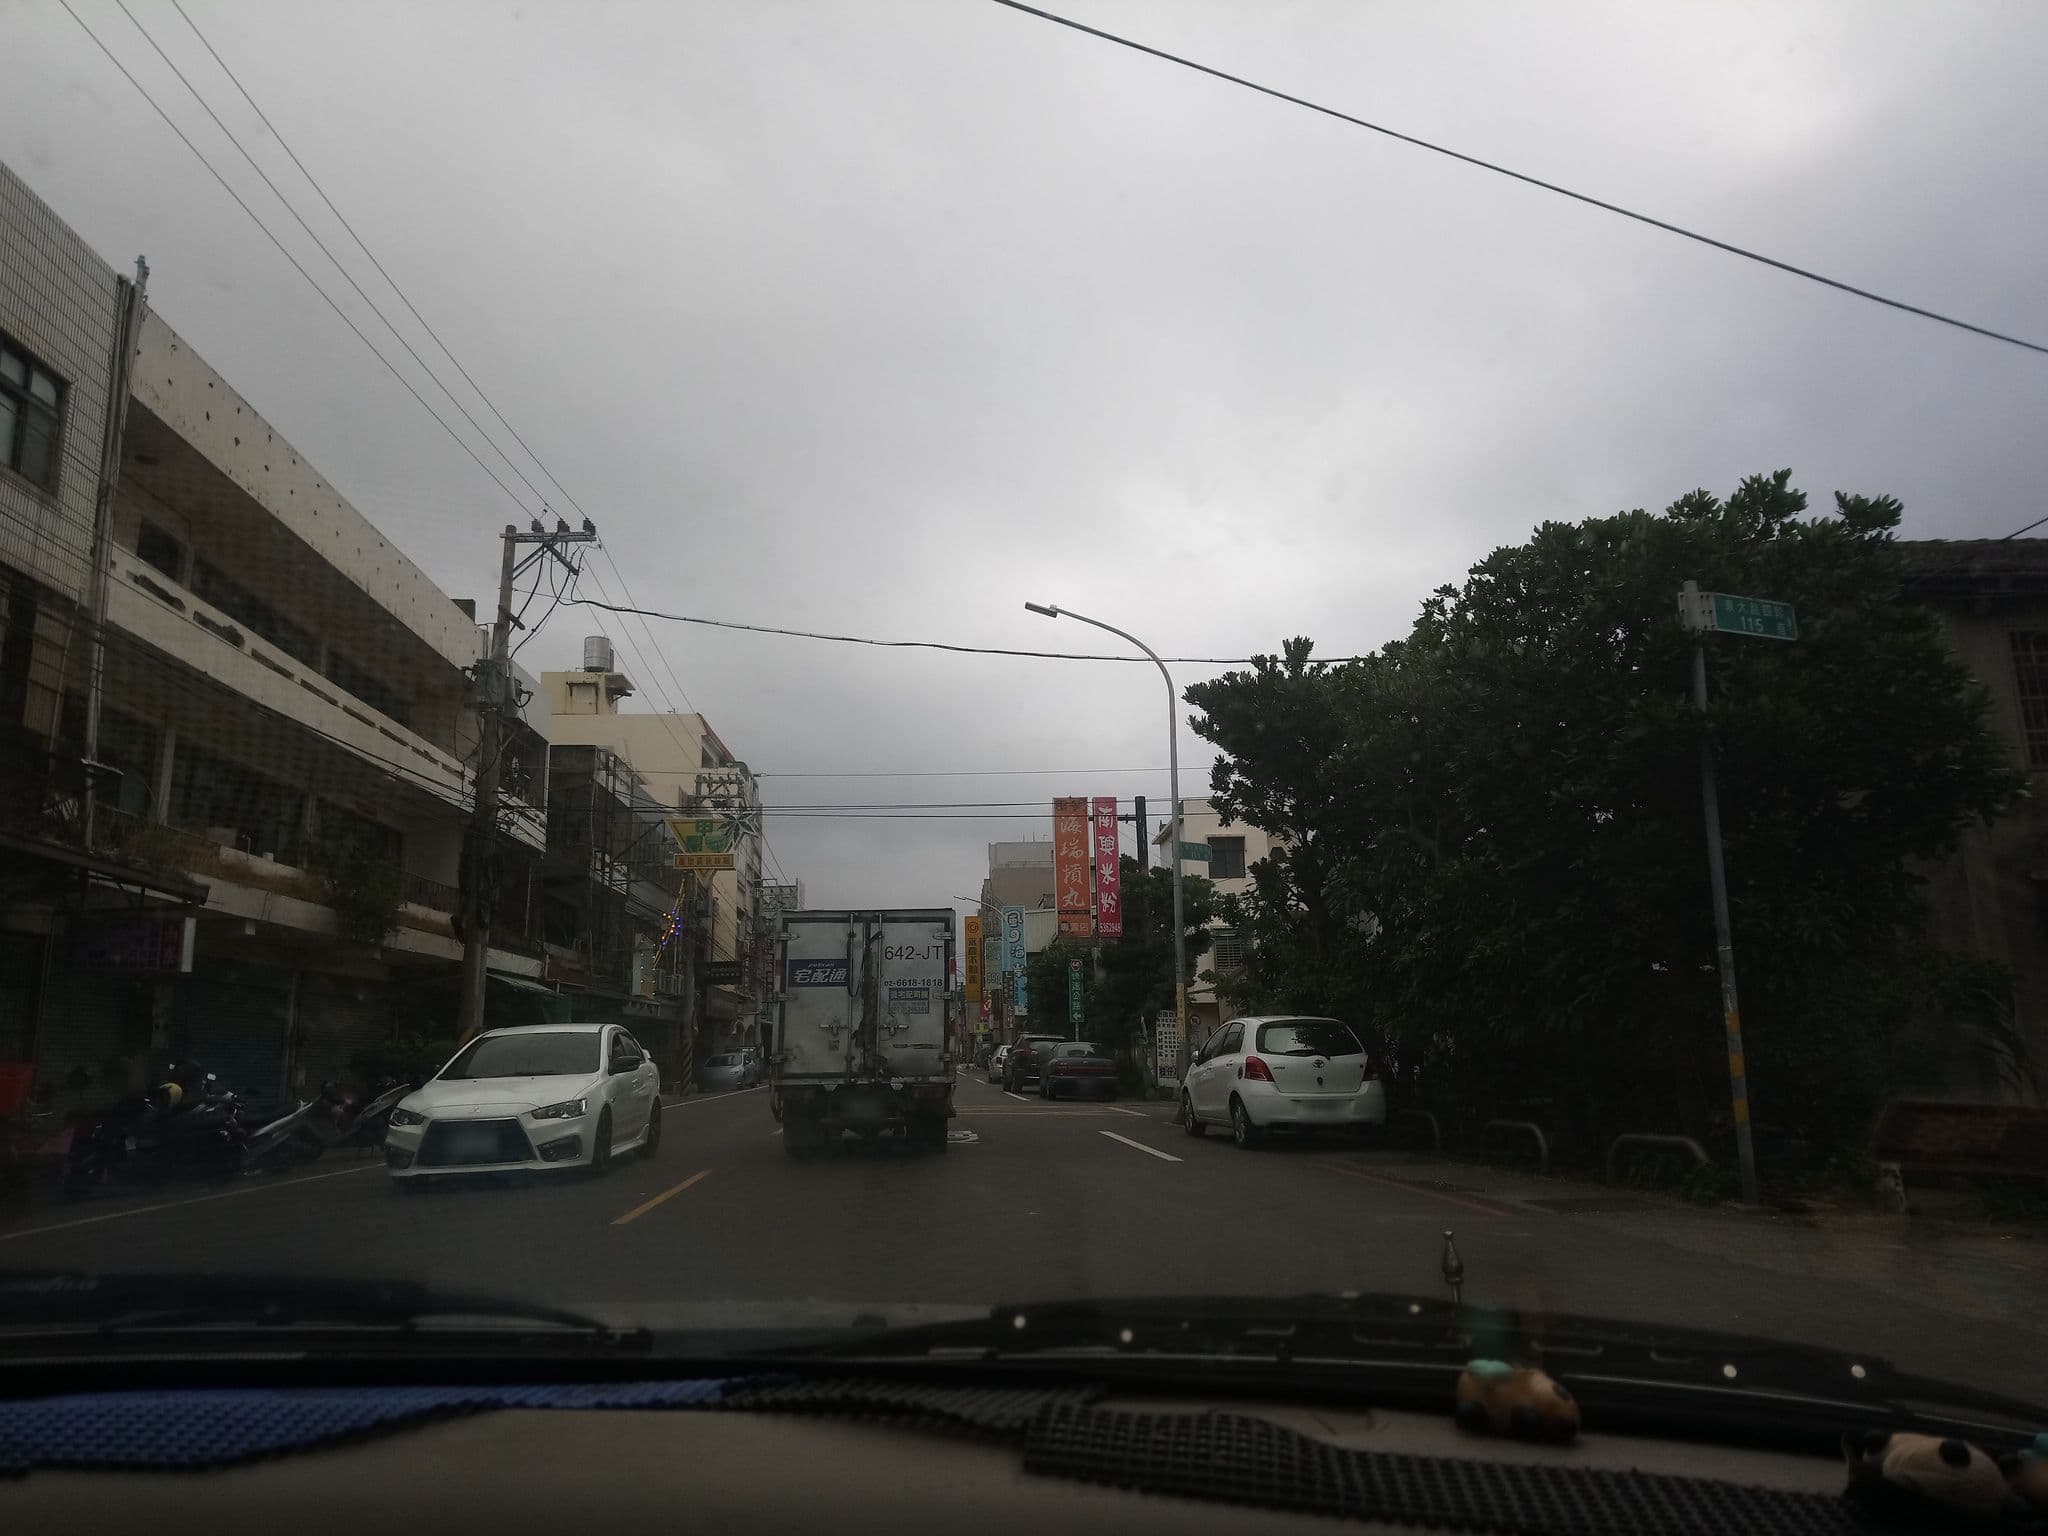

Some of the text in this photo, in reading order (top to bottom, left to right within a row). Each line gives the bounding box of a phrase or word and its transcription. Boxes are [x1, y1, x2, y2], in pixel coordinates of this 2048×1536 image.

[1741, 616, 1764, 633] 115
[884, 945, 943, 960] 642-JT
[793, 968, 847, 983] 宅配通
[884, 978, 943, 987] 02-6618-1818
[889, 988, 929, 999] 宅配司
